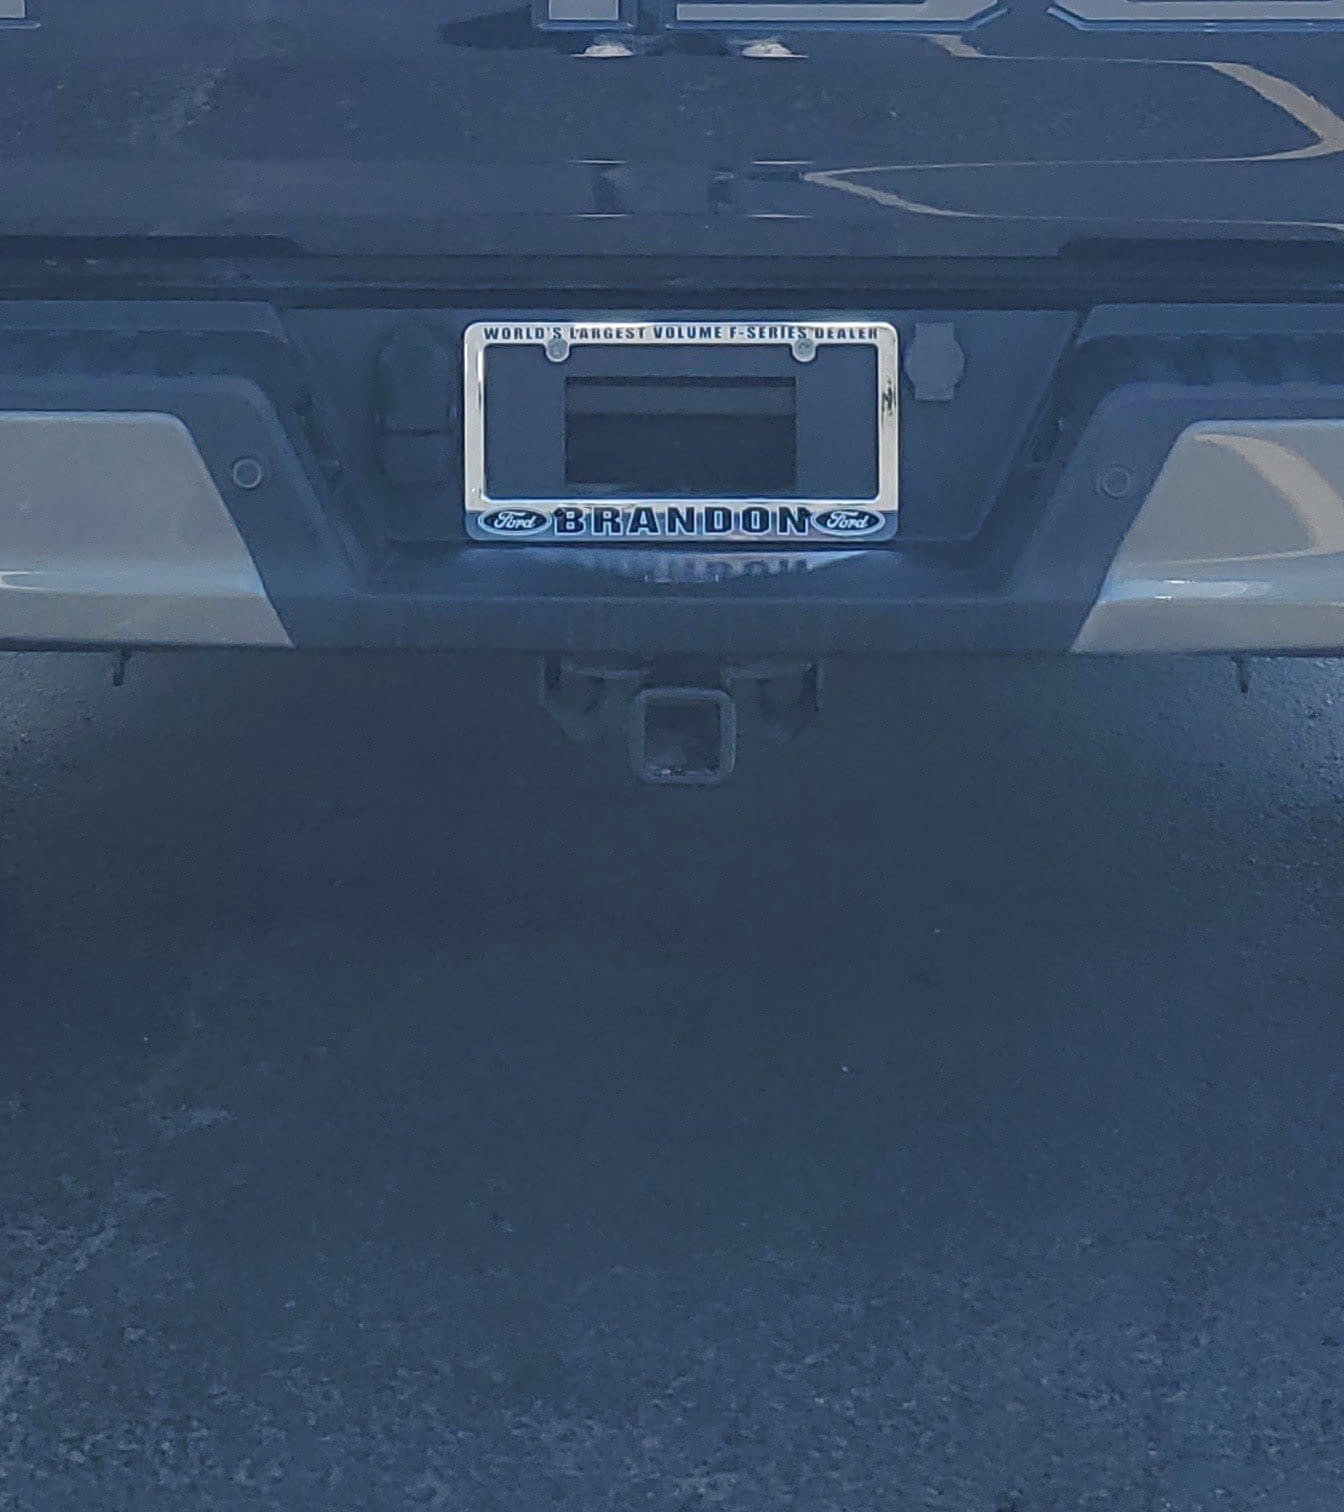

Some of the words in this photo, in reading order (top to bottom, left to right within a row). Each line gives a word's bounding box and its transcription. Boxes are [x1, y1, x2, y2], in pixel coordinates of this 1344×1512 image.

[483, 326, 564, 340] WORLD'S
[569, 326, 646, 340] LARGEST
[653, 326, 723, 340] VOLUME
[729, 326, 808, 340] F-SERIES
[814, 327, 879, 340] DEALER
[493, 510, 537, 530] Ford
[553, 505, 810, 536] BRANDON
[826, 510, 869, 530] Ford
